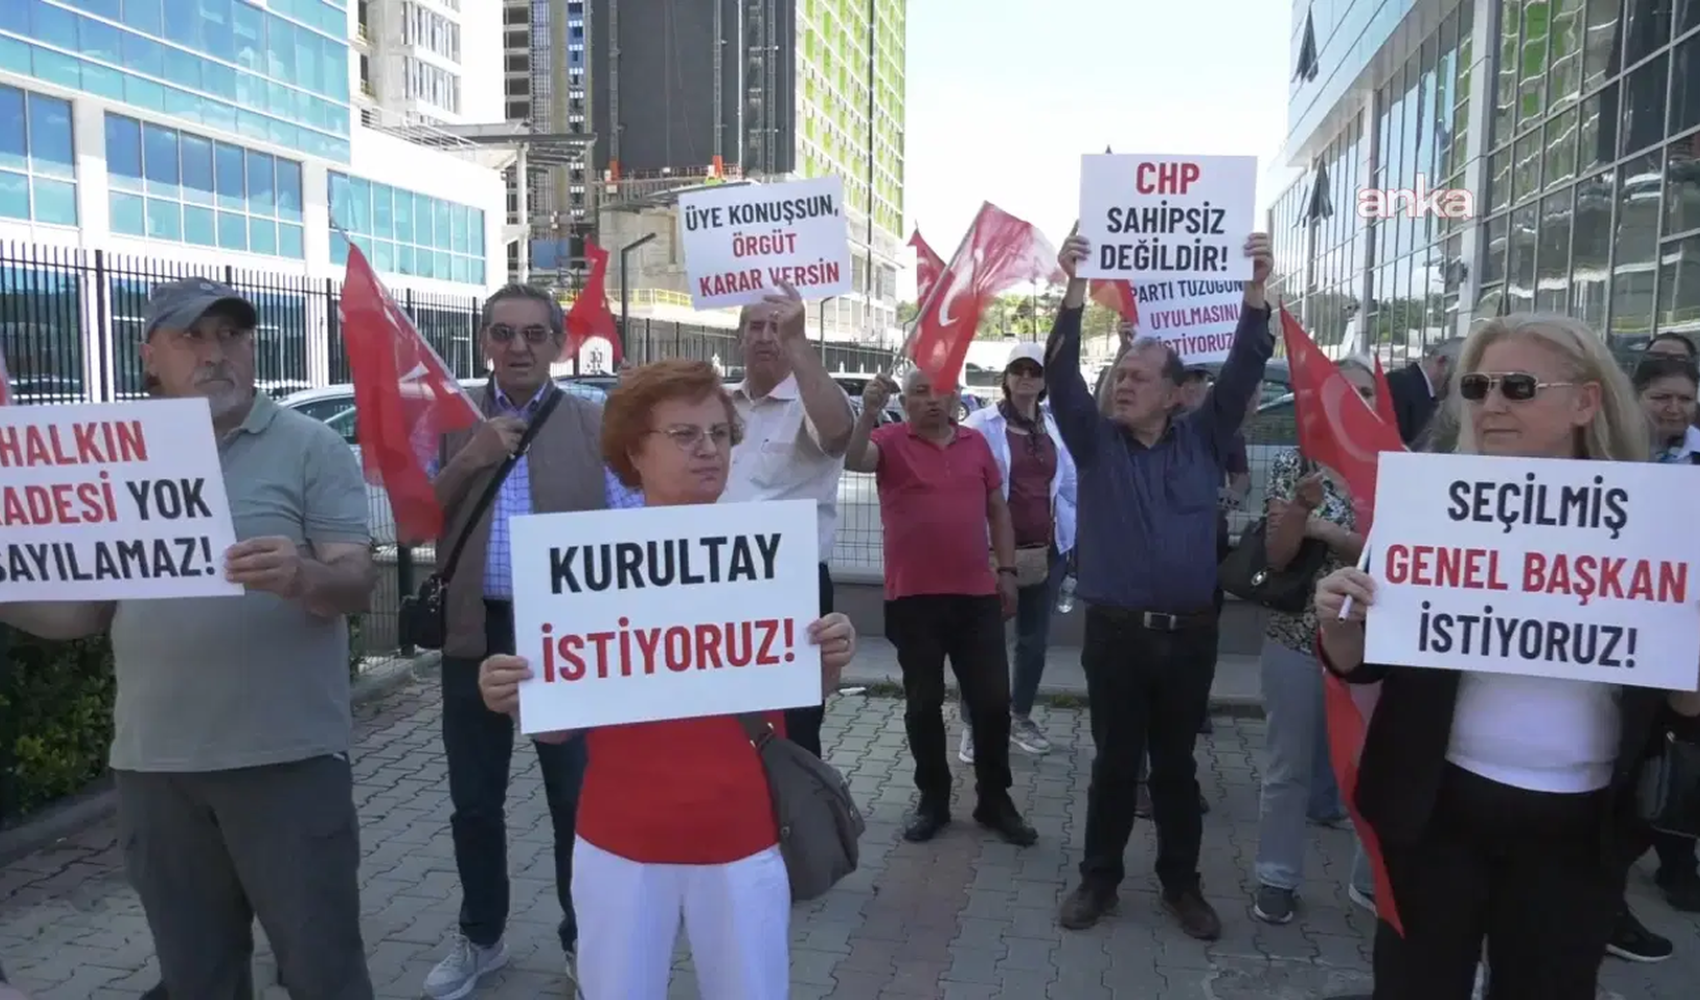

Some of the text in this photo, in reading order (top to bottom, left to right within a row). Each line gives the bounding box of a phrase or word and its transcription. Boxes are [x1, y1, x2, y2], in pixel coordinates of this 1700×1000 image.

[1136, 162, 1200, 195] CHP
[686, 194, 839, 231] ÜYE KONUŞSUN,
[1106, 200, 1226, 234] SAHİPSİZ
[733, 229, 797, 257] ÖRGÜT
[1100, 237, 1228, 272] DEĞİLDİR!
[700, 258, 840, 297] KARAR VERSİN
[1150, 303, 1239, 330] UYULMASINI
[0, 420, 148, 467] HALKIN
[0, 470, 212, 526] ADESİ YOK
[1447, 472, 1628, 539] SEÇİLMİŞ
[550, 533, 782, 594] KURULTAY
[1385, 544, 1687, 606] GENEL BAŞKAN
[541, 616, 795, 683] İSTİYORUZ!
[1418, 600, 1638, 669] İSTİYORUZ!
